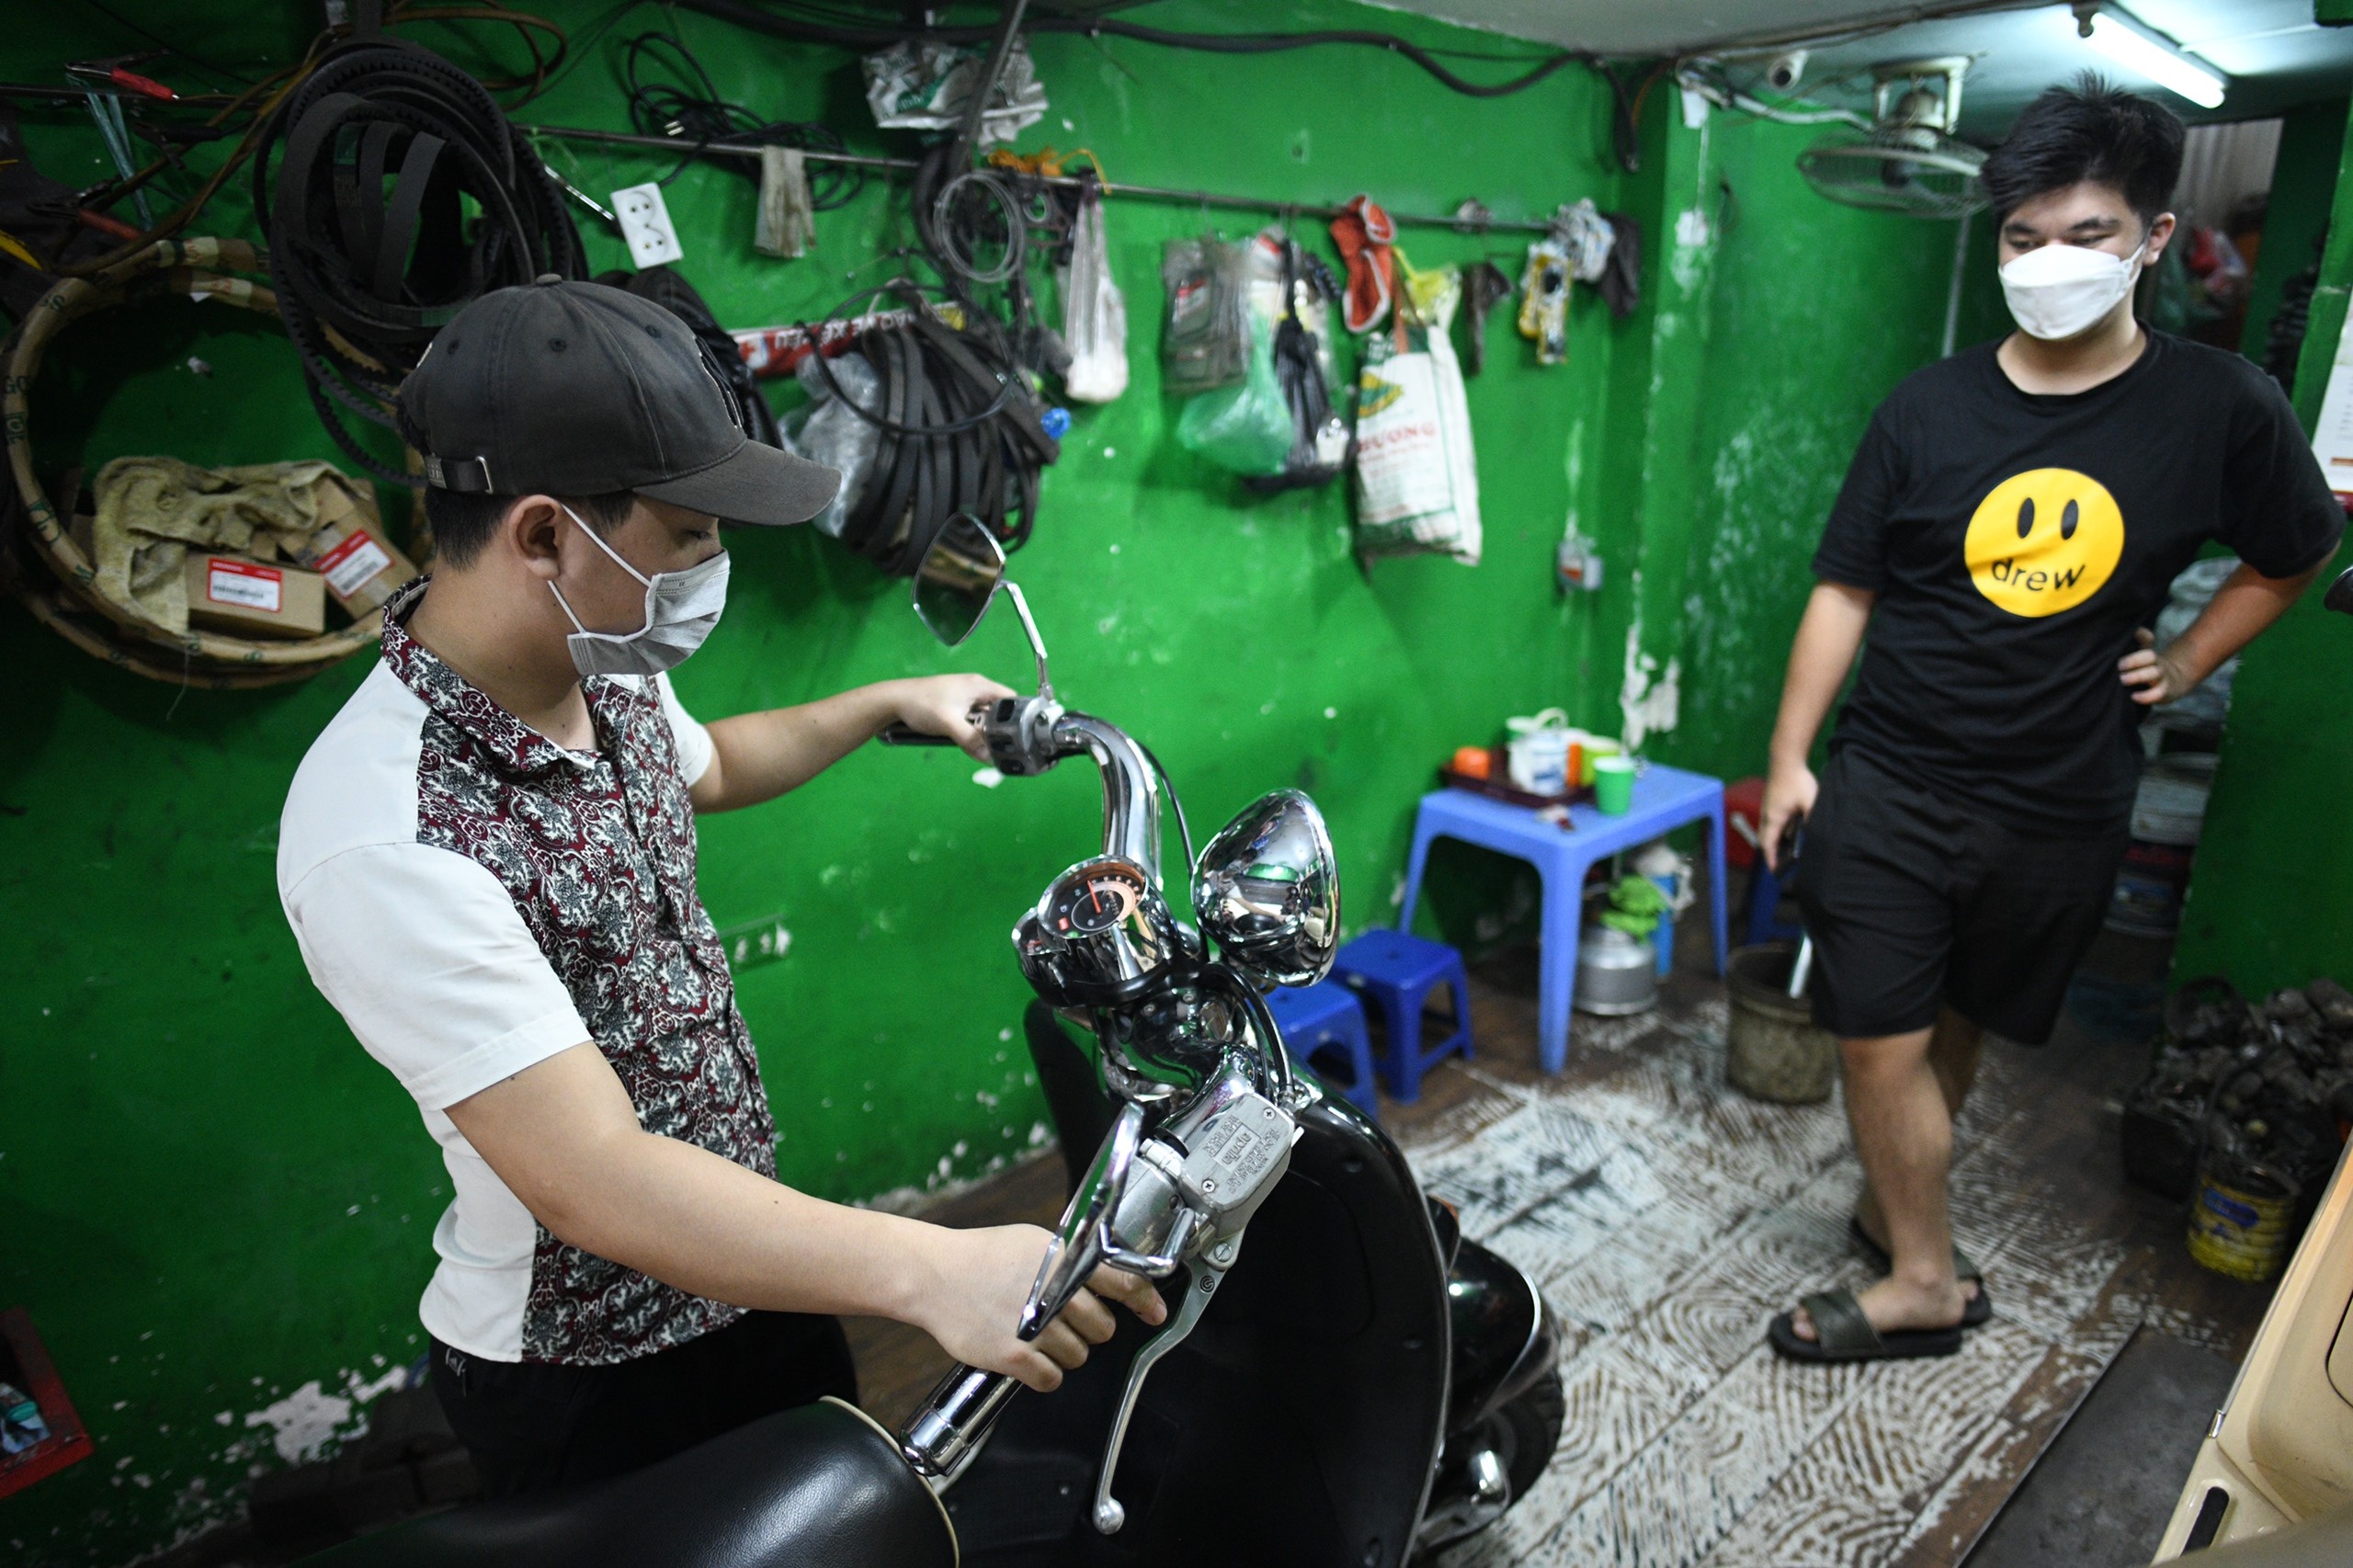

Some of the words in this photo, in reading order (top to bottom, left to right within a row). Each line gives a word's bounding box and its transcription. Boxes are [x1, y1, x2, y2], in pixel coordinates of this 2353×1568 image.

[1991, 556, 2086, 592] drew
[1262, 1128, 1275, 1142] FROM
[1222, 1131, 1252, 1165] aprilia
[1239, 1165, 1253, 1180] BRAKE
[1251, 1156, 1269, 1176] WARNING
